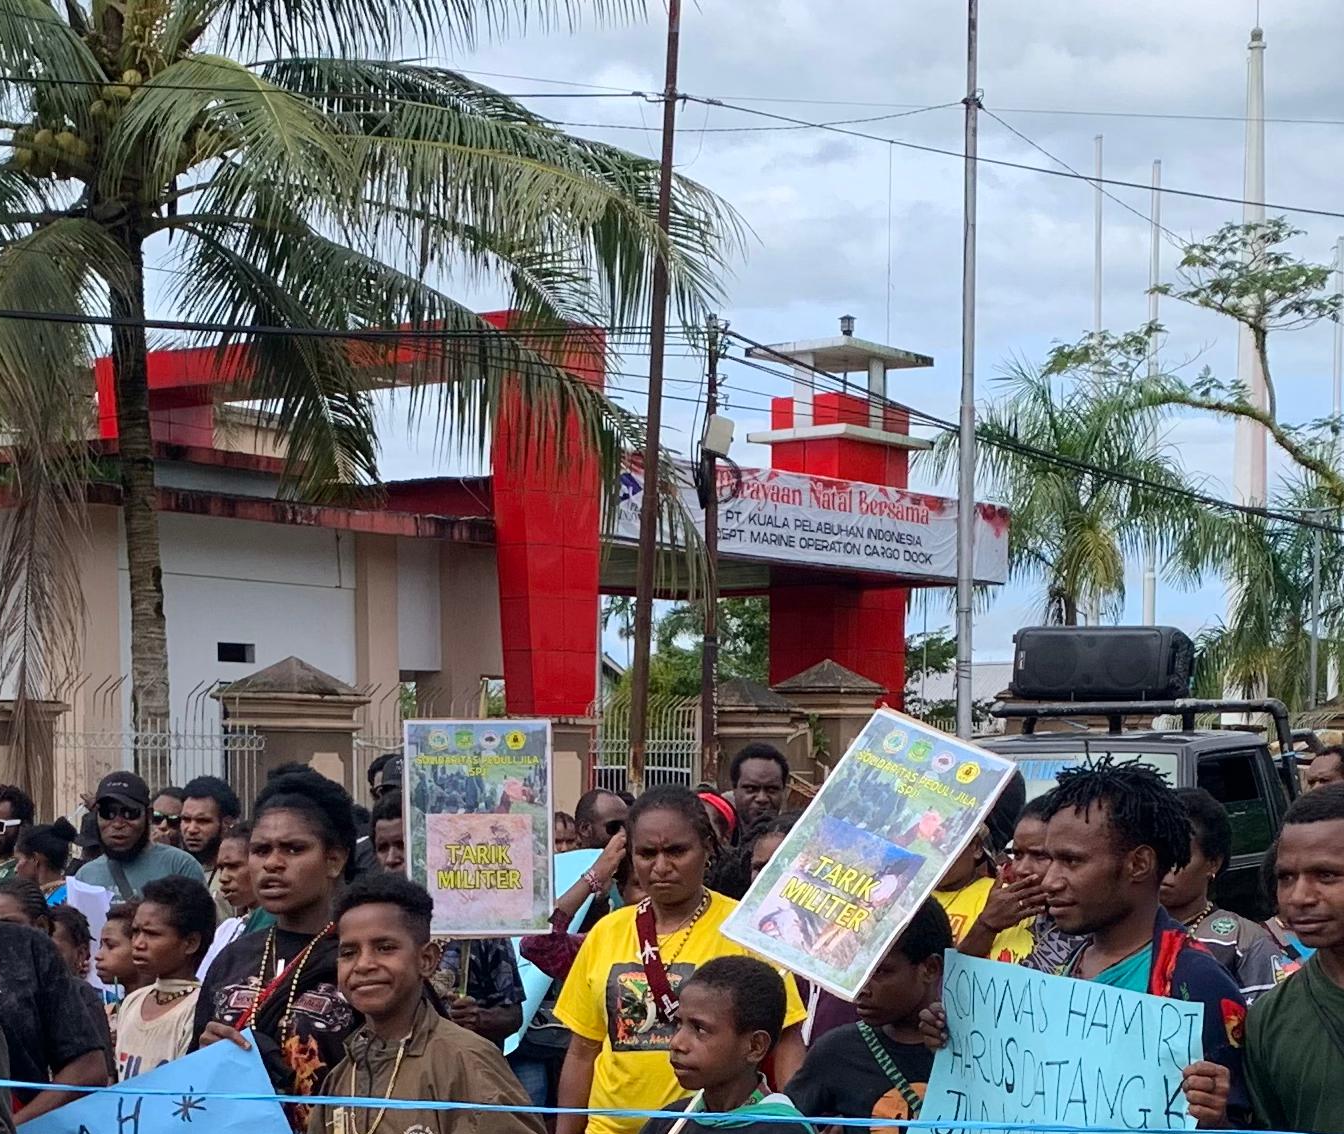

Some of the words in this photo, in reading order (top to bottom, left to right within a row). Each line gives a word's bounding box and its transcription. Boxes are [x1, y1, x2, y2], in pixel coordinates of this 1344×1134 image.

[809, 481, 853, 514] Natal
[859, 490, 931, 526] Bersama
[748, 512, 790, 530] KUALA
[794, 519, 865, 540] PELABUHAN
[867, 527, 923, 548] INDONESIA
[750, 531, 796, 548] MARINE
[798, 537, 861, 556] OPERATION
[864, 544, 901, 561] CARGO
[903, 550, 933, 566] DOCK
[444, 843, 512, 865] TARIK
[436, 869, 523, 890] MILITER
[810, 855, 882, 904] TARIK
[779, 875, 874, 934] MILITER
[1065, 981, 1147, 1061] HAM
[1020, 1050, 1151, 1132] DATANG
